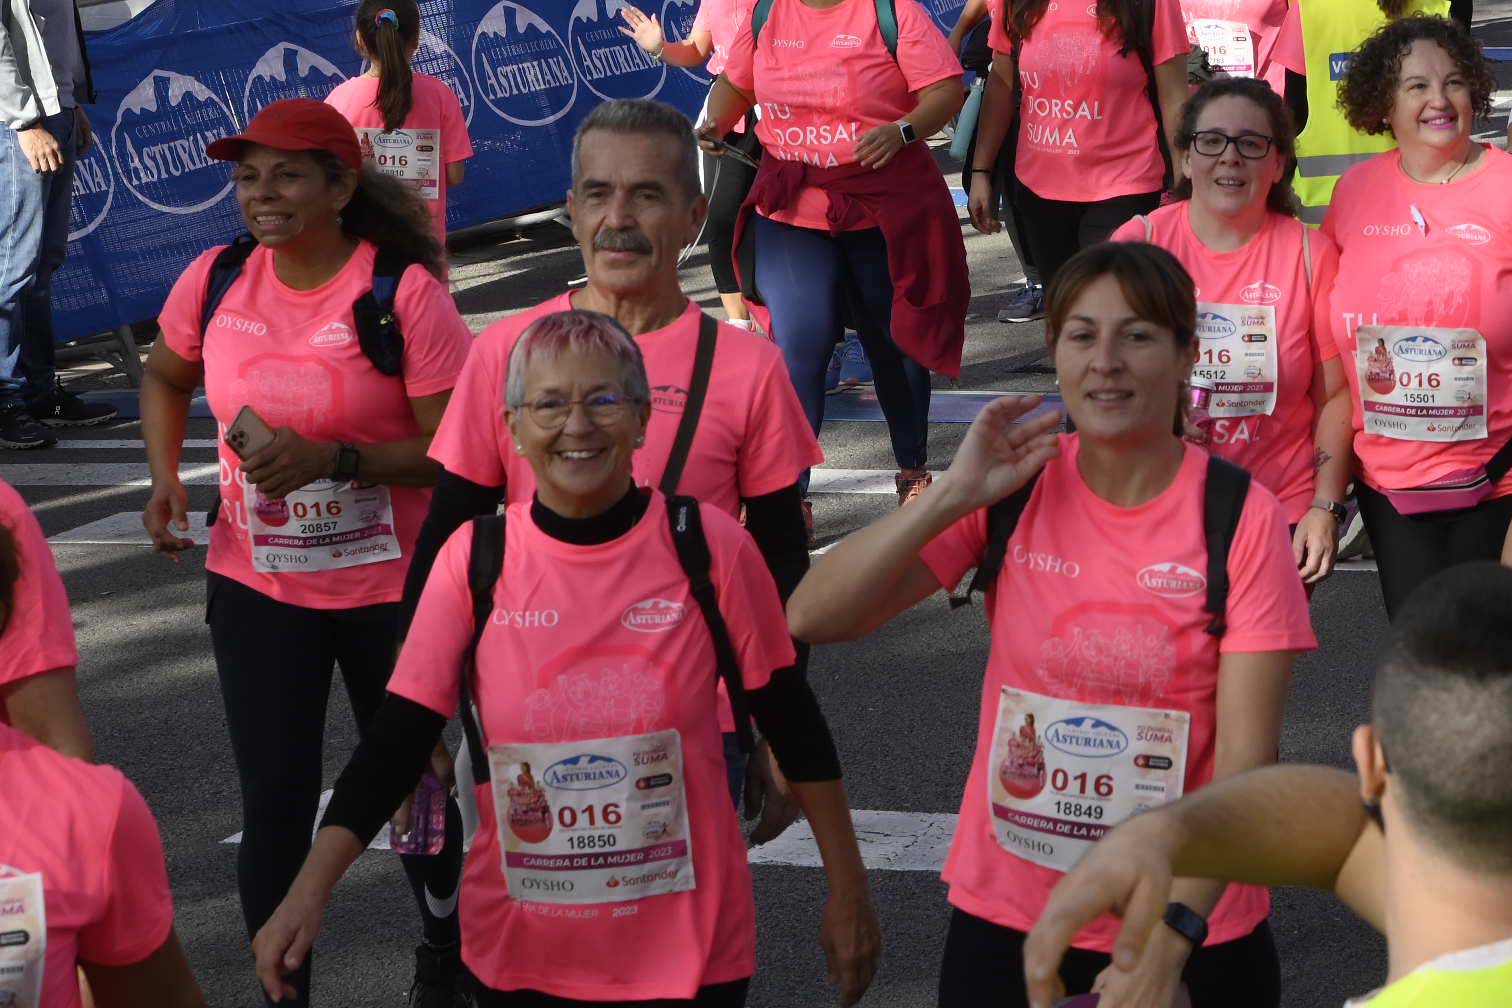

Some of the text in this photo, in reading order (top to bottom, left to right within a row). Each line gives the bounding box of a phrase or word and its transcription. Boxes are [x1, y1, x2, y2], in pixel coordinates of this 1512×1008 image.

[482, 52, 574, 100] ASTURIANA
[1027, 97, 1104, 120] DORSAL
[1027, 123, 1079, 148] SUMA
[377, 154, 409, 167] 016
[1362, 223, 1411, 236] OYSHO
[215, 314, 268, 336] OYSHO
[1240, 319, 1265, 328] SUMA
[1398, 345, 1445, 358] ASTURIANA
[1450, 342, 1476, 350] SUMA
[1193, 369, 1226, 381] 15512
[1399, 372, 1441, 389] 016
[1219, 384, 1245, 392] MUJER
[1226, 398, 1266, 408] Santander
[1403, 393, 1436, 404] 15501
[1375, 404, 1454, 416] CARRERA DE LA MUJER
[1374, 419, 1477, 433] OYSHO Santander
[292, 500, 342, 519] 016
[299, 521, 339, 534] 20857
[267, 535, 304, 545] CARRERA
[306, 535, 317, 545] DE
[318, 534, 330, 544] LA
[331, 531, 361, 543] MUJER
[265, 542, 389, 565] OYSHO Santander
[1013, 545, 1080, 578] OYSHO
[1142, 574, 1202, 591] ASTURIANA
[493, 609, 560, 629] OYSHO
[1051, 727, 1122, 750] ASTURIANA
[1136, 732, 1173, 744] SUMA
[633, 752, 669, 766] SUMA
[549, 767, 620, 785] ASTURIANA
[1051, 768, 1114, 797] 016
[558, 802, 622, 828] 016
[1054, 800, 1104, 820] 18849
[1007, 812, 1088, 836] CARRERA DE LA
[567, 834, 617, 850] 18850
[1006, 830, 1054, 856] OYSHO
[523, 846, 674, 867] CARRERA DE LA MUJER 2023
[521, 869, 680, 892] OYSHO Santander
